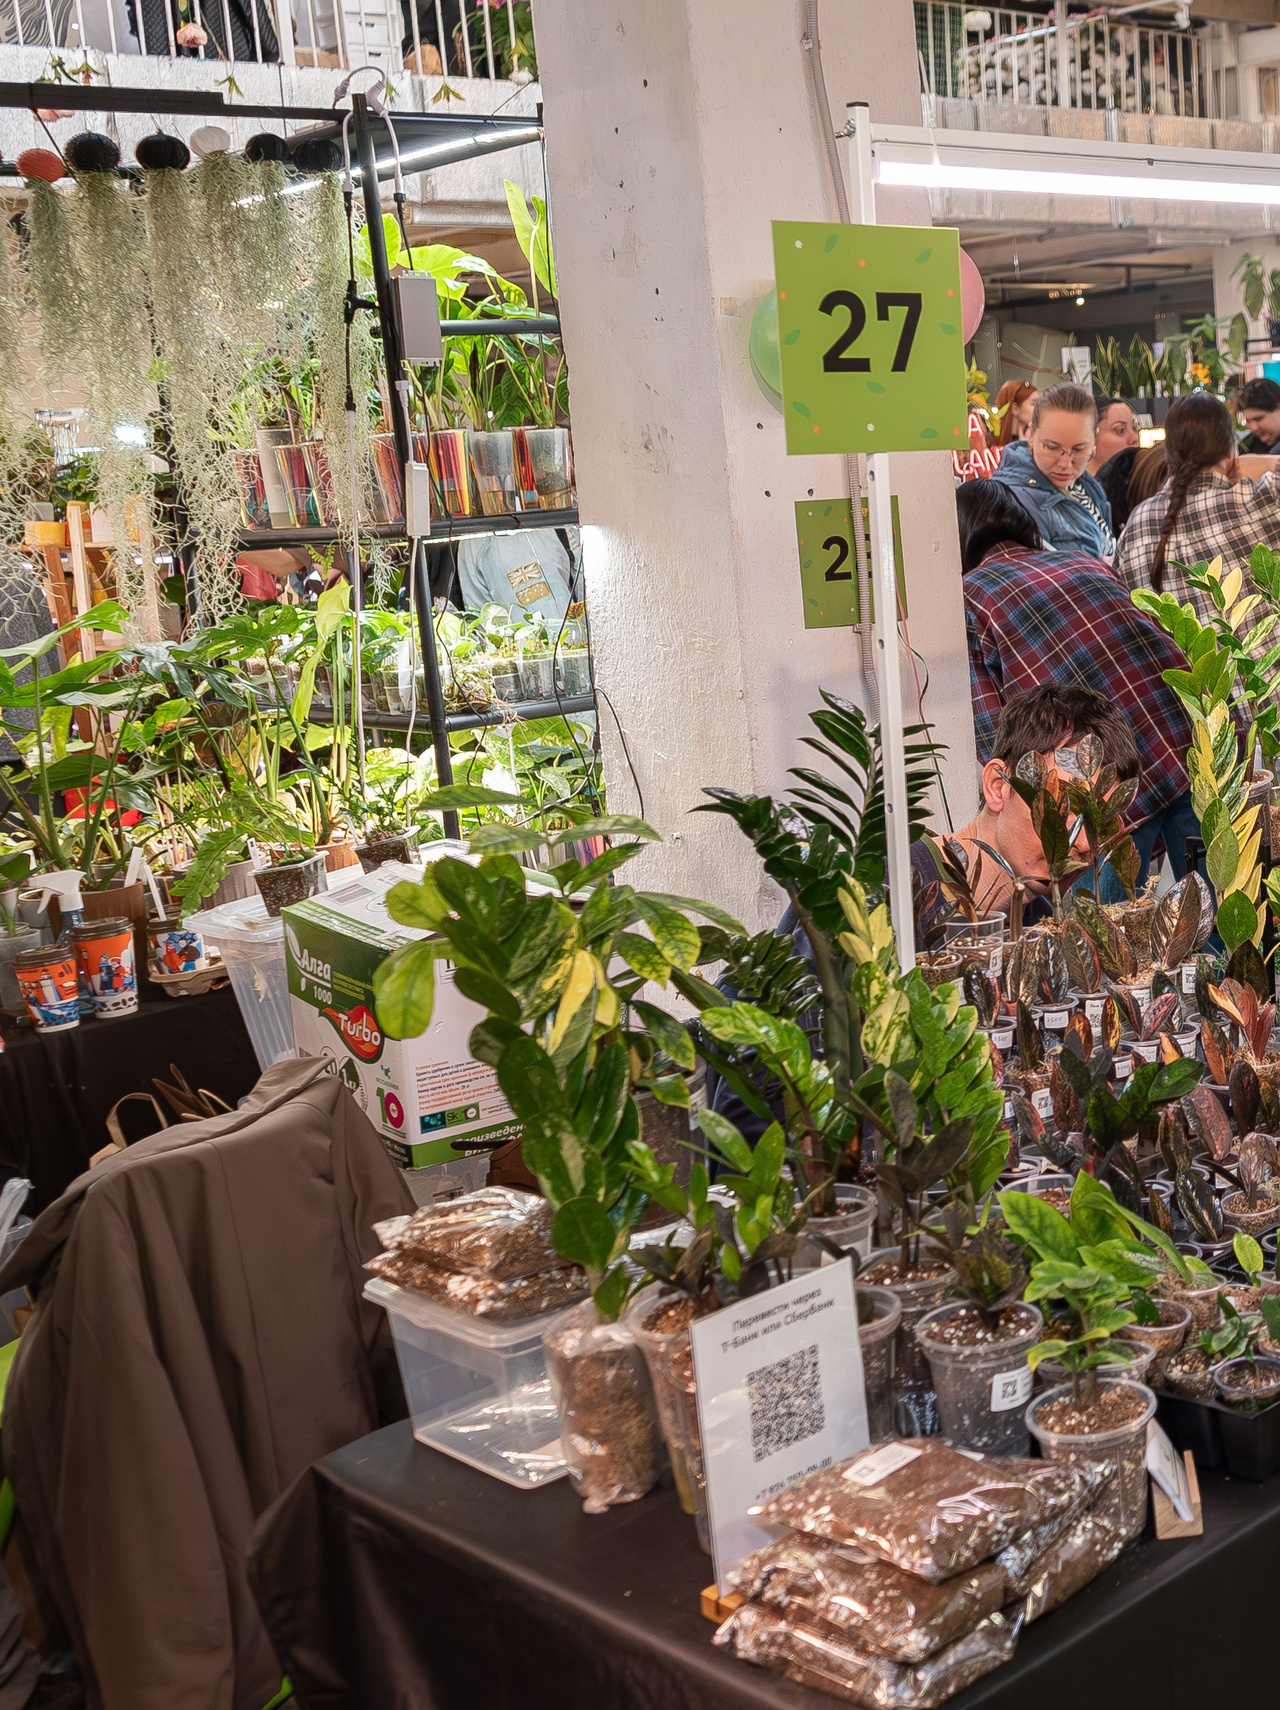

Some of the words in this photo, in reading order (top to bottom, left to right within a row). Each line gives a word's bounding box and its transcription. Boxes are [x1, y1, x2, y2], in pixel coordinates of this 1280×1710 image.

[818, 289, 923, 373] 27
[312, 984, 333, 1005] 1000
[338, 1010, 381, 1046] Turbo
[732, 1302, 790, 1332] Перевести
[792, 1287, 822, 1308] через
[783, 1297, 835, 1326] Сбербанк
